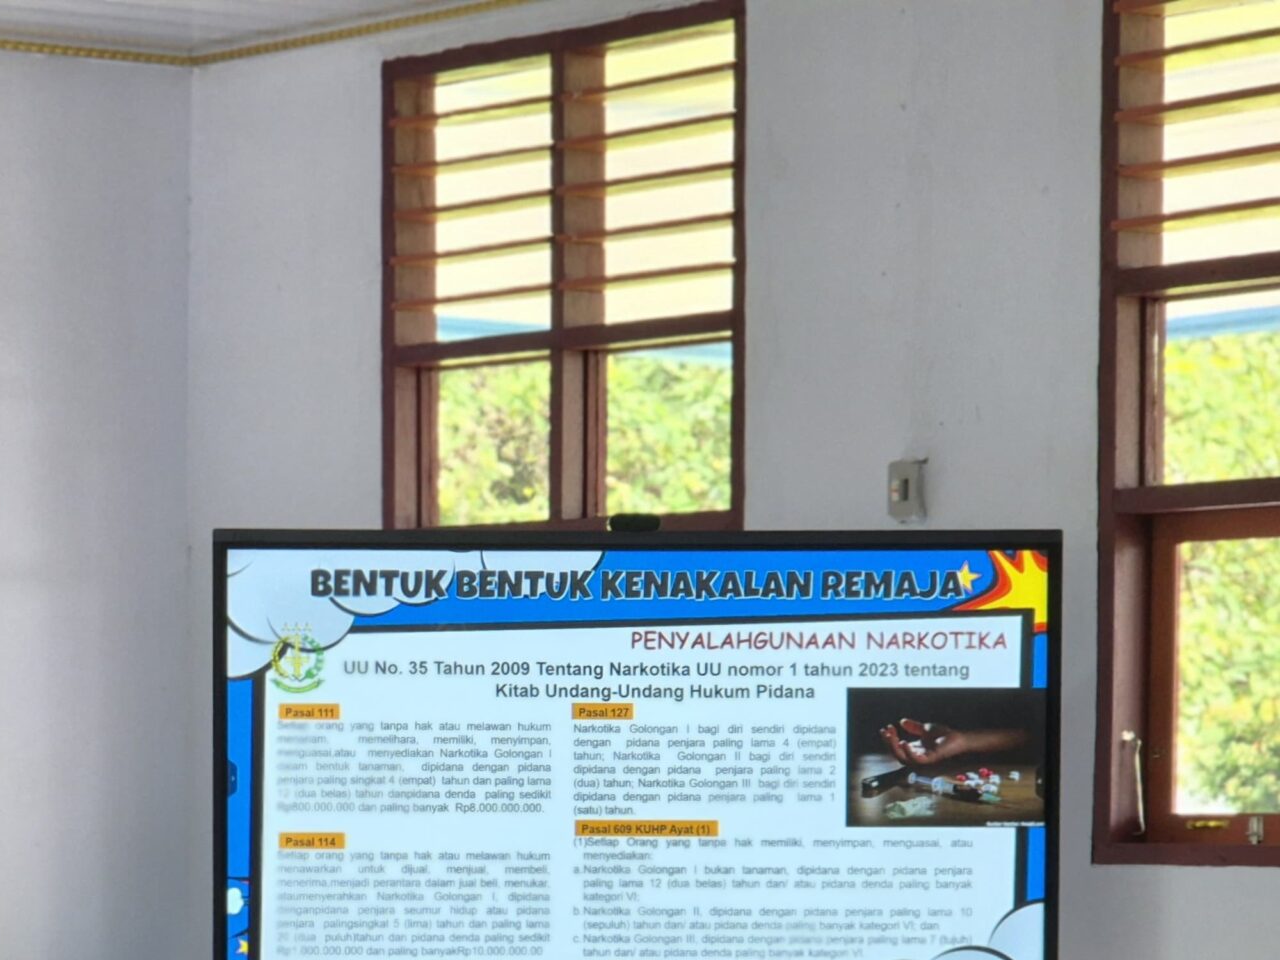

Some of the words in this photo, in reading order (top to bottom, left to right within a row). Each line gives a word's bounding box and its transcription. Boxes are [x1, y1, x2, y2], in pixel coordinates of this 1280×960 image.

[311, 569, 448, 598] BENTUK
[455, 570, 594, 600] BENTUK
[601, 570, 813, 600] KENAKALAN
[821, 570, 965, 600] REMAJA
[631, 631, 856, 650] PENYALAHGUNAAN
[866, 631, 1008, 650] NARKOTIKA
[344, 660, 369, 676] UU
[374, 660, 402, 676] No.
[409, 660, 428, 676] 35
[434, 660, 485, 676] Tahun
[491, 660, 530, 676] 2009
[536, 660, 604, 680] Tentang
[609, 660, 690, 676] Narkotika
[696, 660, 721, 676] UU
[727, 664, 782, 676] nomor
[789, 660, 796, 676] 1
[804, 660, 853, 676] tahun
[858, 660, 898, 676] 2023
[904, 660, 970, 680] tentang
[495, 683, 540, 698] Kitab
[545, 683, 684, 702] Undang-Undang
[690, 683, 751, 698] Hukum
[756, 683, 815, 698] Pidana
[285, 708, 315, 718] Pasal
[318, 708, 335, 718] 111
[578, 707, 608, 718] Pasal
[609, 707, 629, 718] 127
[350, 723, 375, 734] yang
[381, 721, 409, 734] tanpa
[414, 721, 433, 731] hak
[438, 721, 461, 731] atau
[466, 721, 512, 731] melawan
[517, 721, 552, 731] hukum
[573, 724, 621, 734] Narkotika
[629, 724, 679, 737] Golongan
[698, 724, 720, 737] bagi
[727, 724, 743, 734] diri
[750, 724, 784, 734] sendiri
[792, 724, 837, 737] dipidana
[573, 737, 611, 750] dengan
[626, 737, 660, 750] pidana
[667, 737, 706, 750] penjara
[712, 737, 743, 750] paling
[750, 737, 776, 747] lama
[581, 824, 612, 835] Pasal
[613, 824, 632, 835] 609
[635, 824, 668, 835] KUHP
[669, 824, 694, 837] Ayat
[696, 824, 711, 837] (1)
[285, 837, 315, 847] Pasal
[318, 837, 336, 847] 114
